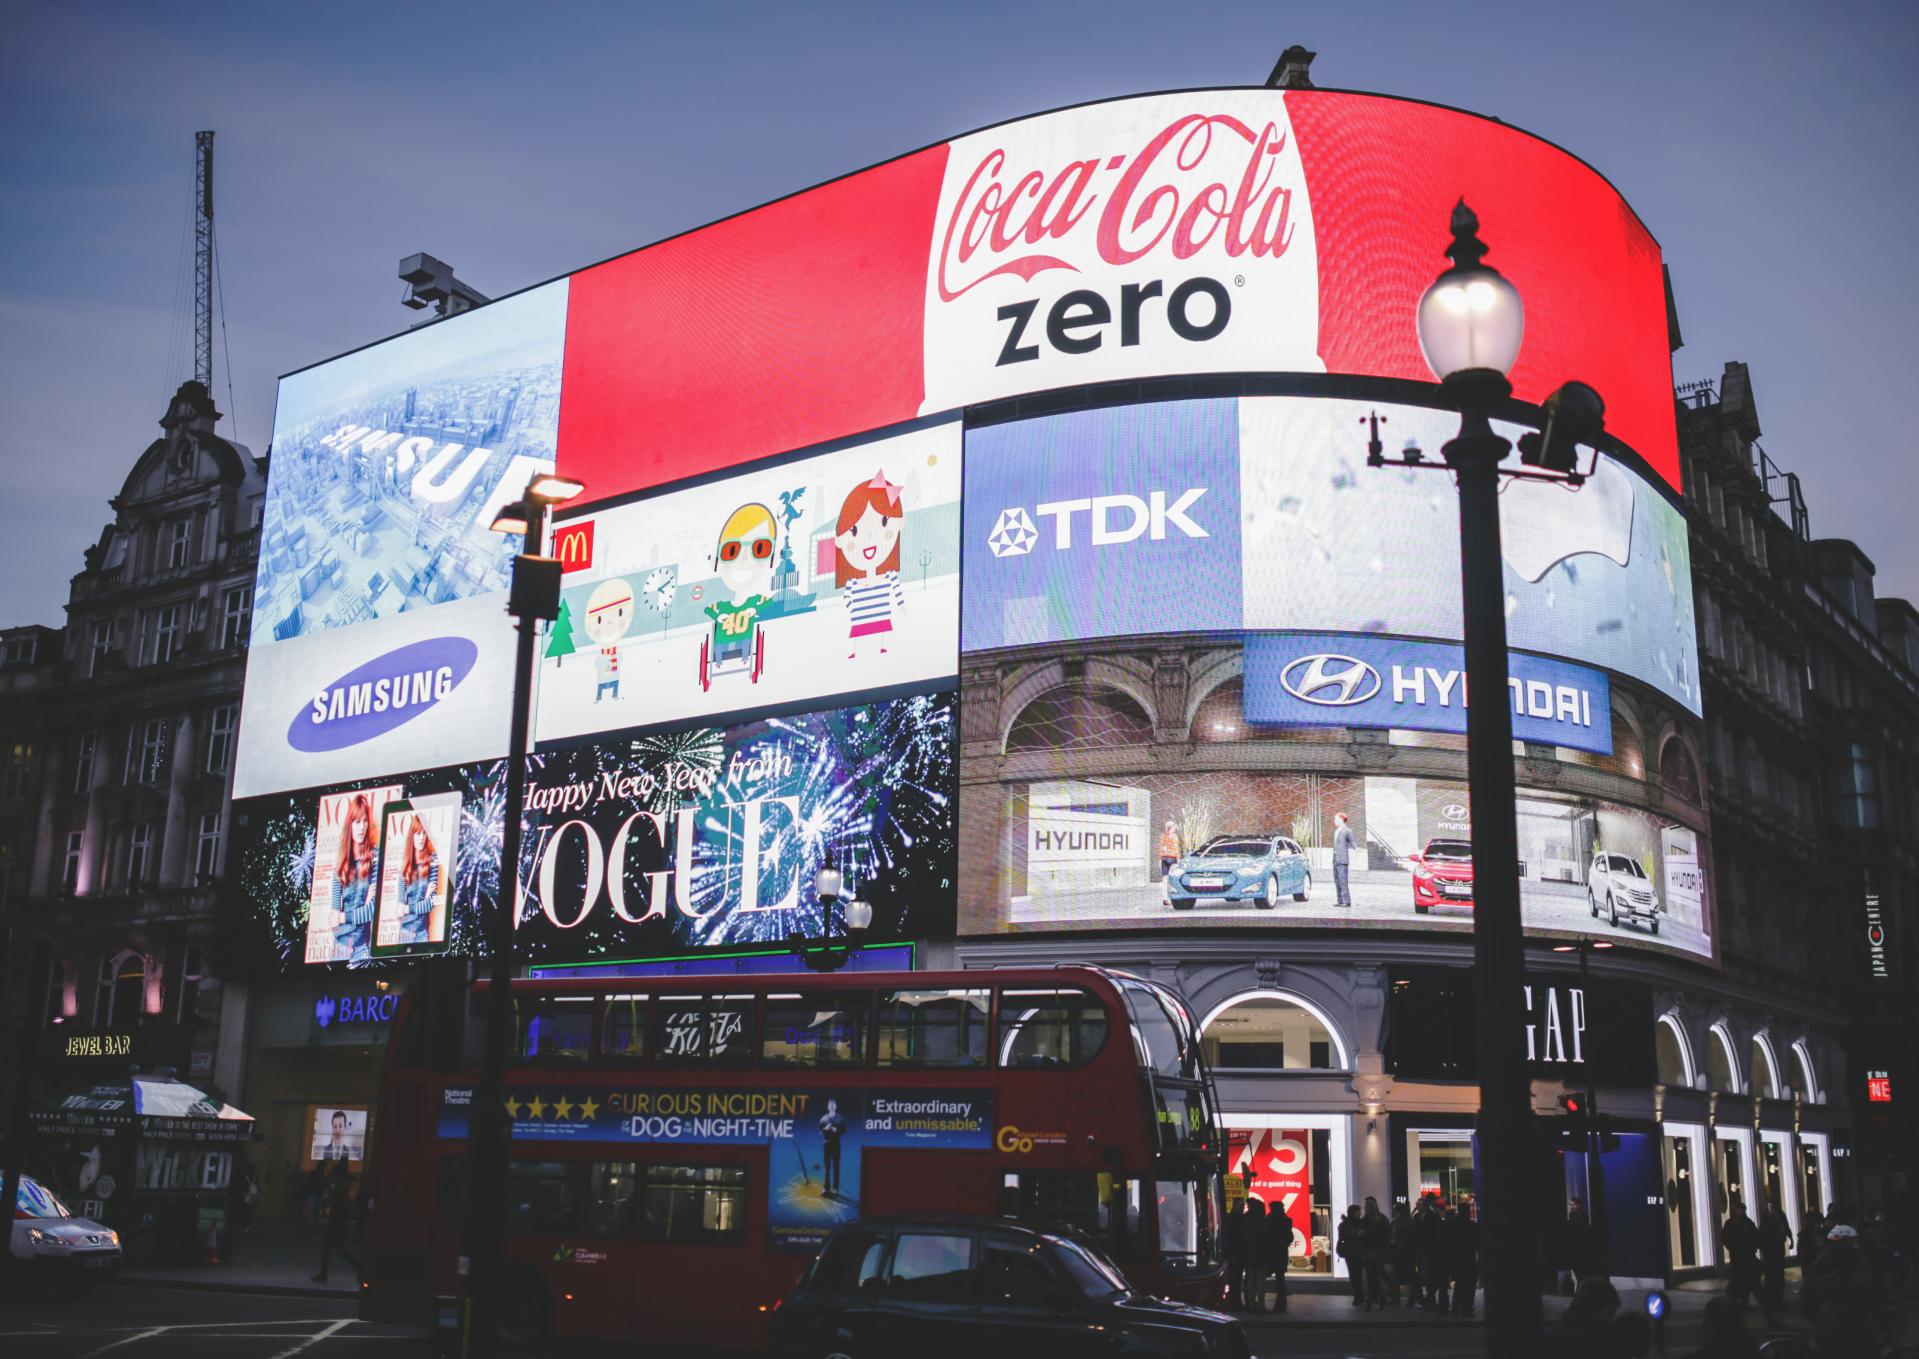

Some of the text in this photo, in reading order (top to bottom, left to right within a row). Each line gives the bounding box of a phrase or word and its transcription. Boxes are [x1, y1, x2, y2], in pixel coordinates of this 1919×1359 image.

[939, 113, 1296, 302] Coca-Cola
[995, 277, 1232, 367] zero
[1036, 488, 1210, 550] TDK
[310, 666, 452, 724] SAMSUNG
[597, 770, 656, 803] New
[663, 760, 722, 793] Year
[725, 750, 793, 789] from
[1036, 831, 1129, 851] HYUNDAI
[1870, 945, 1888, 977] JAPAN
[66, 1035, 131, 1056] JEWEL BAR
[444, 1088, 473, 1097] National
[444, 1097, 471, 1105] Theatre
[608, 1093, 810, 1116] CURIOUS INCIDENT
[631, 1116, 795, 1139] DOG NIGHT-TIME
[865, 1117, 892, 1131] and
[1254, 1180, 1262, 1188] of
[1268, 1180, 1285, 1189] good
[1286, 1180, 1302, 1189] thing
